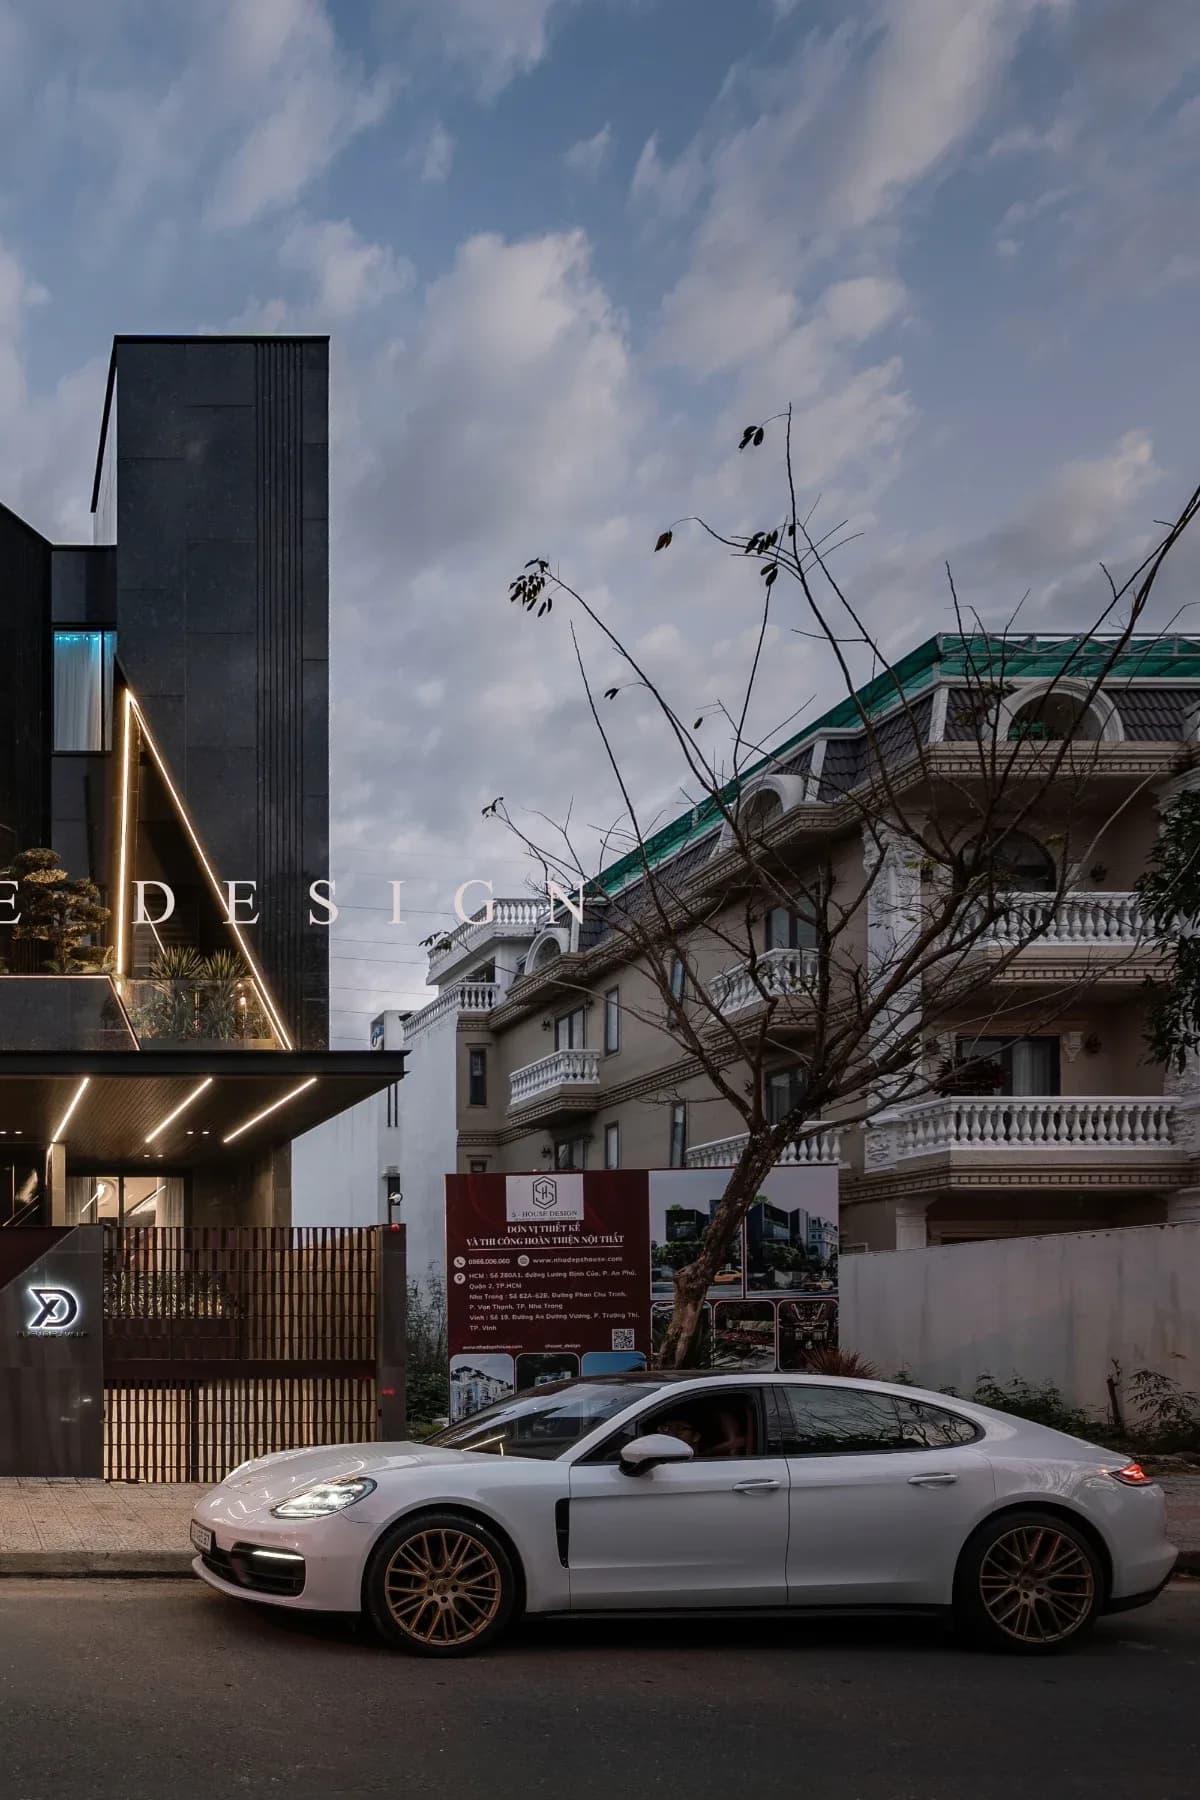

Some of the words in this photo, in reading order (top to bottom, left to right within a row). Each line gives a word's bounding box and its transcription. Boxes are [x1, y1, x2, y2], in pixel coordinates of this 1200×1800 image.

[522, 1210, 548, 1218] HOUSE
[549, 1209, 578, 1217] DESIGN
[507, 1223, 528, 1234] ĐƠN
[528, 1225, 539, 1234] VỊ
[539, 1221, 567, 1233] THIẾT
[568, 1221, 581, 1232] KẾ
[466, 1236, 479, 1247] VÀ
[480, 1238, 496, 1246] THI
[497, 1236, 524, 1246] CÔNG
[524, 1235, 550, 1245] HOÀN
[552, 1234, 580, 1246] THIỆN
[581, 1234, 598, 1245] NỘI
[599, 1231, 625, 1243] THẤT
